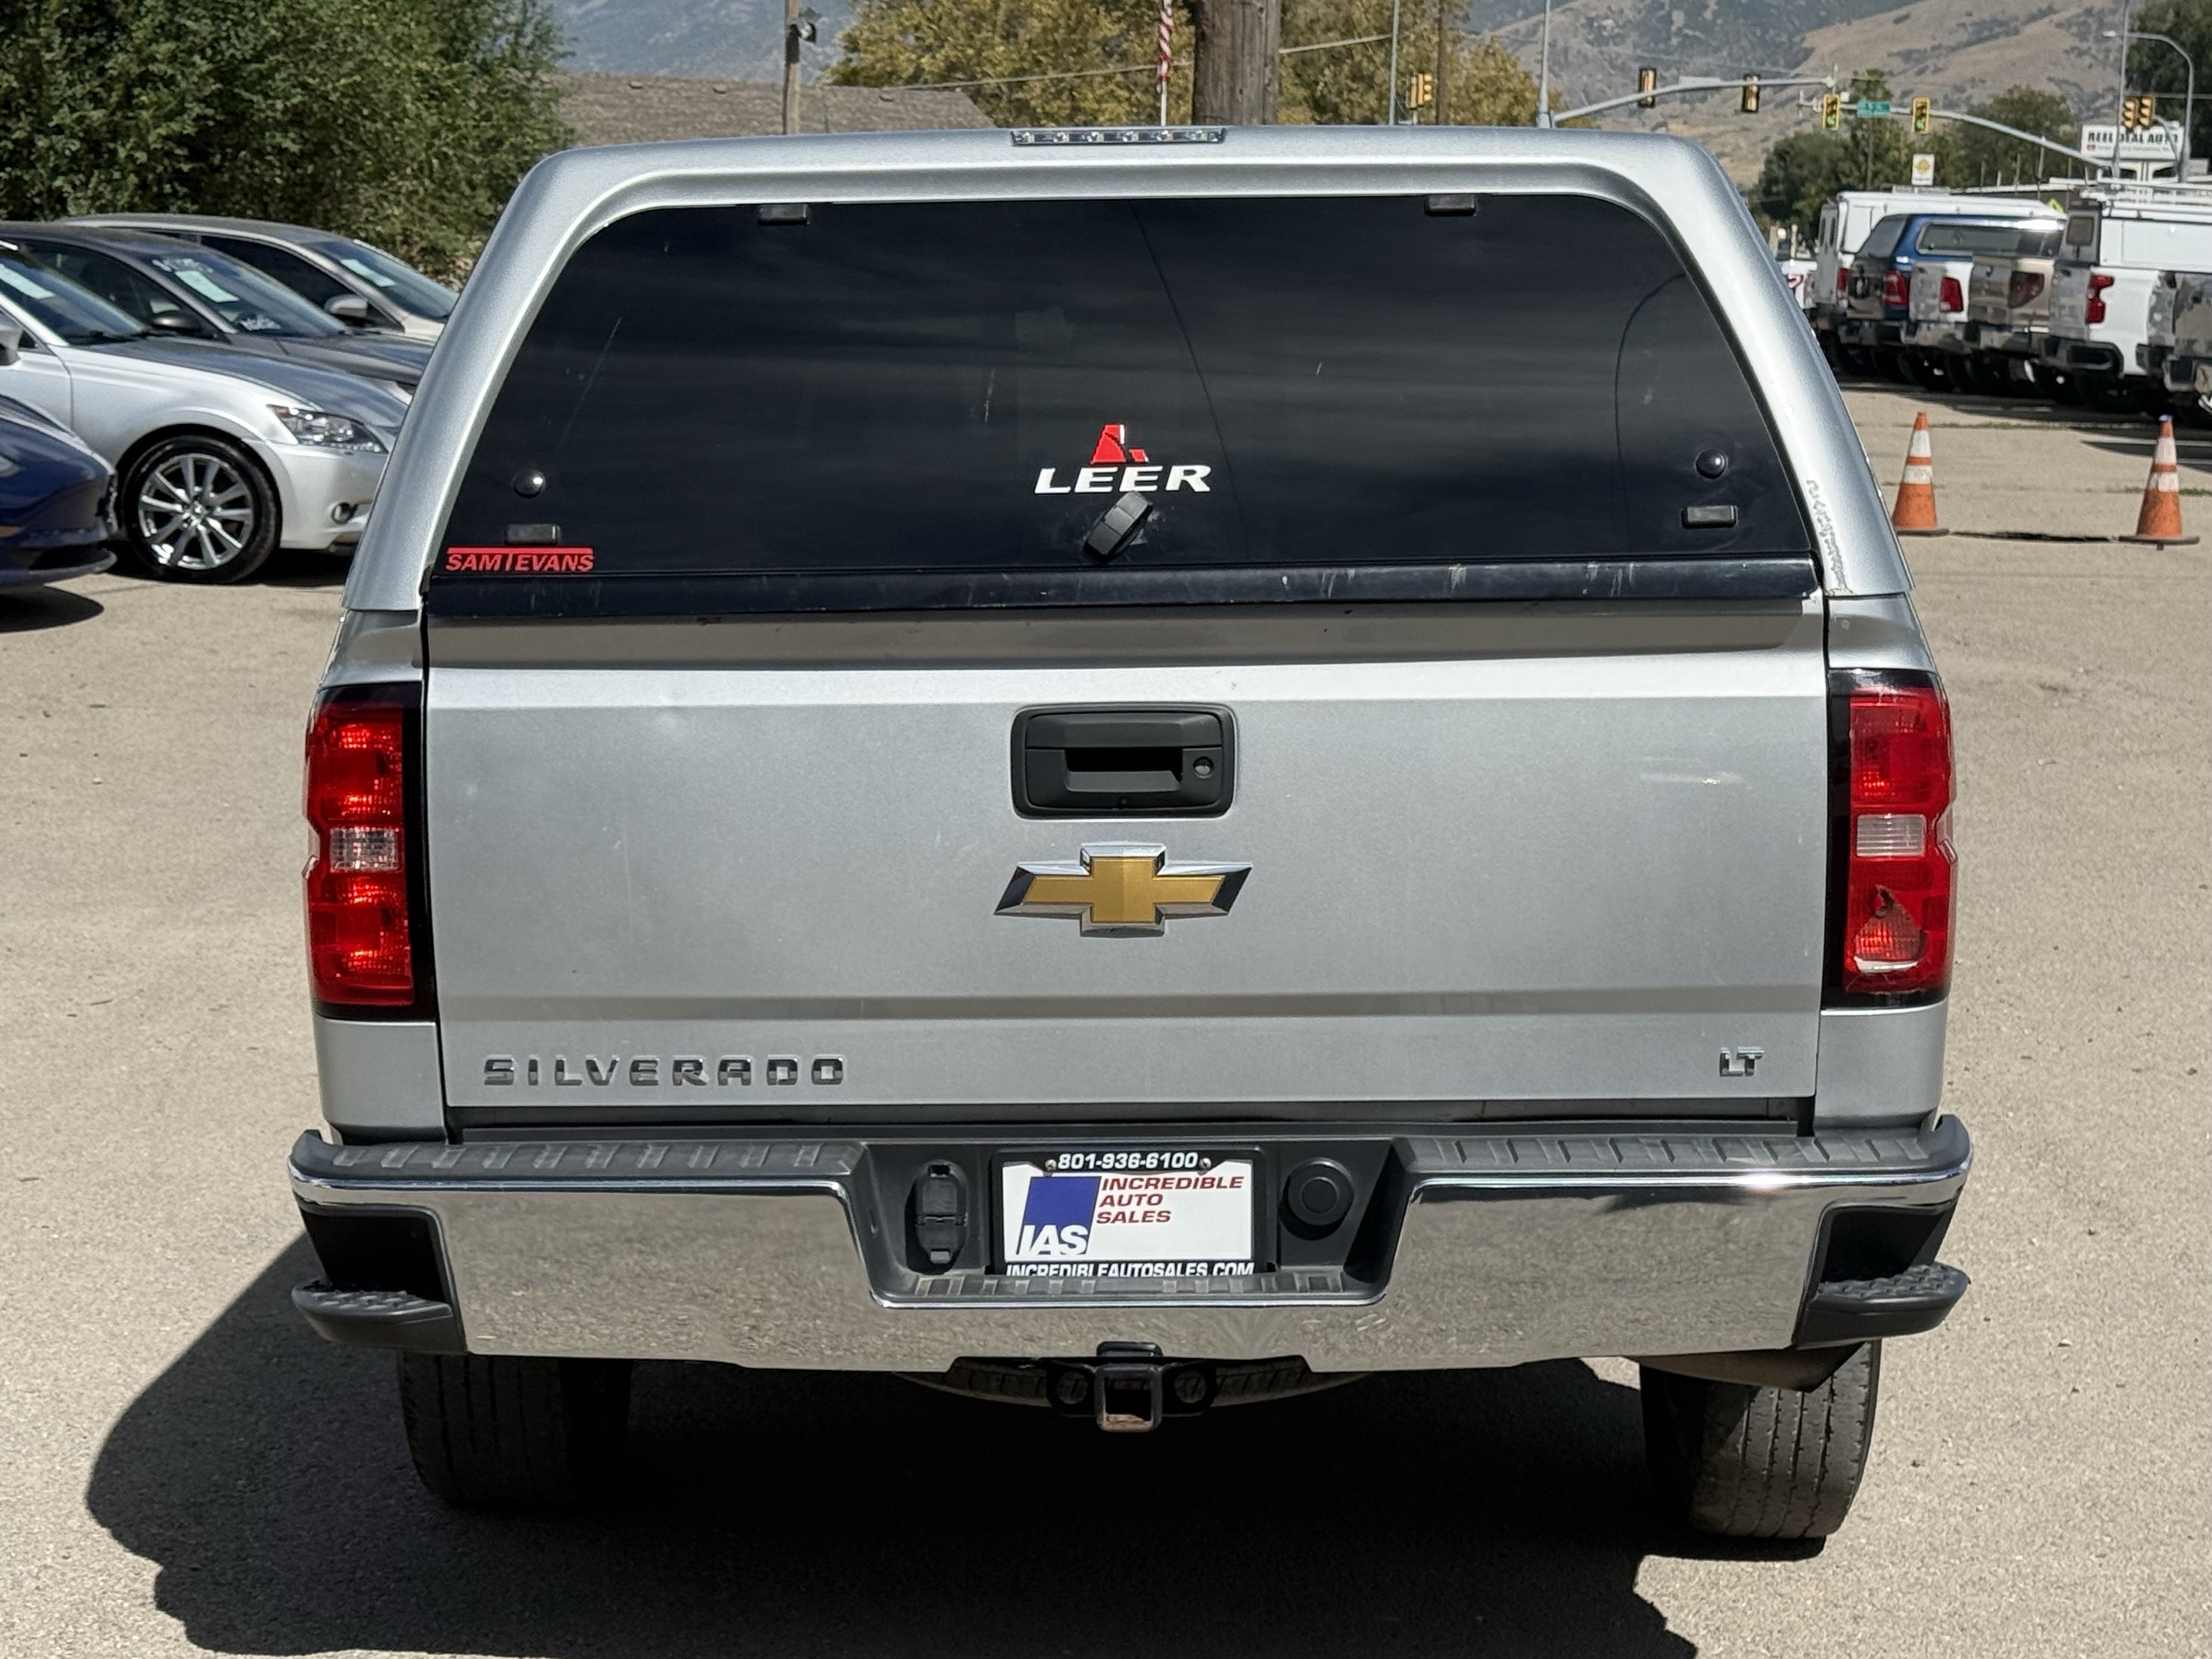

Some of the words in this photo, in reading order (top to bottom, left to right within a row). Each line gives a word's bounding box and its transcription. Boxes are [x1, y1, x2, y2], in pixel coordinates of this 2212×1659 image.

[1034, 465, 1211, 494] LEER
[483, 1054, 845, 1087] SILVERADO
[1719, 1046, 1765, 1077] LT
[1058, 1152, 1198, 1170] 801-936-6100
[1102, 1176, 1245, 1190] INCREDIBLE
[1099, 1193, 1164, 1207] AUTO
[1096, 1210, 1171, 1224] SALES
[1017, 1224, 1089, 1255] IAS
[1006, 1262, 1255, 1277] INCREDIBLEAUTOSALESCOM
